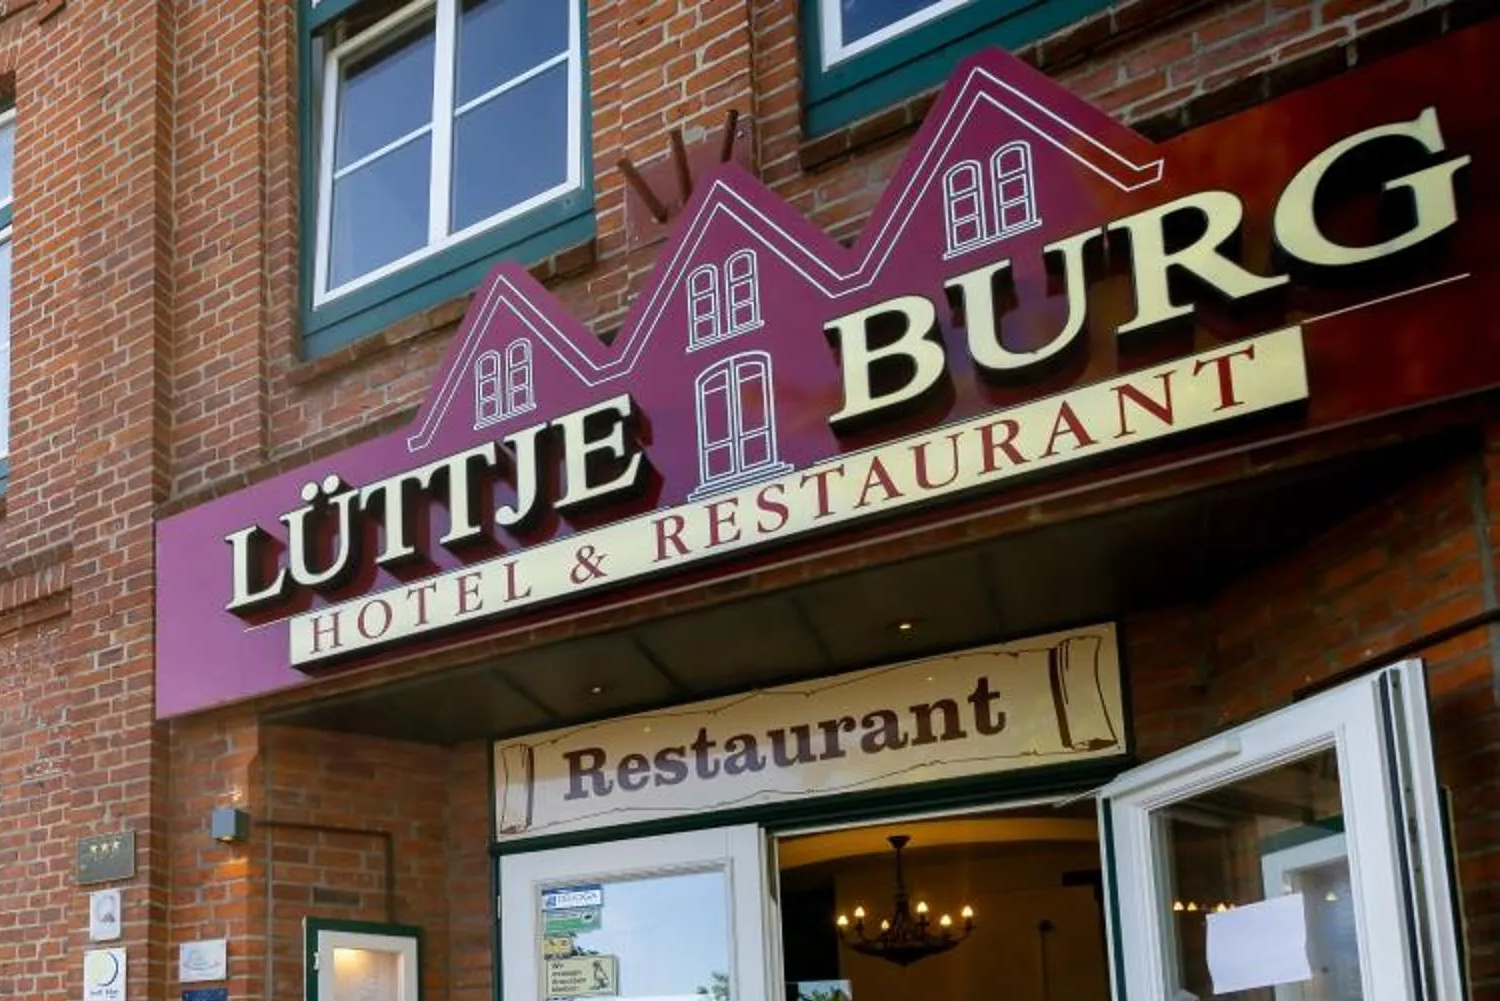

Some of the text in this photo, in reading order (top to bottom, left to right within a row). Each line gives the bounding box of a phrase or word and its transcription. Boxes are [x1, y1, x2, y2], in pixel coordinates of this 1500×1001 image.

[224, 105, 1472, 611] LÜTTJE BURG
[308, 344, 1257, 655] HOTEL & RESTAURANT
[562, 675, 1007, 801] Restaurant
